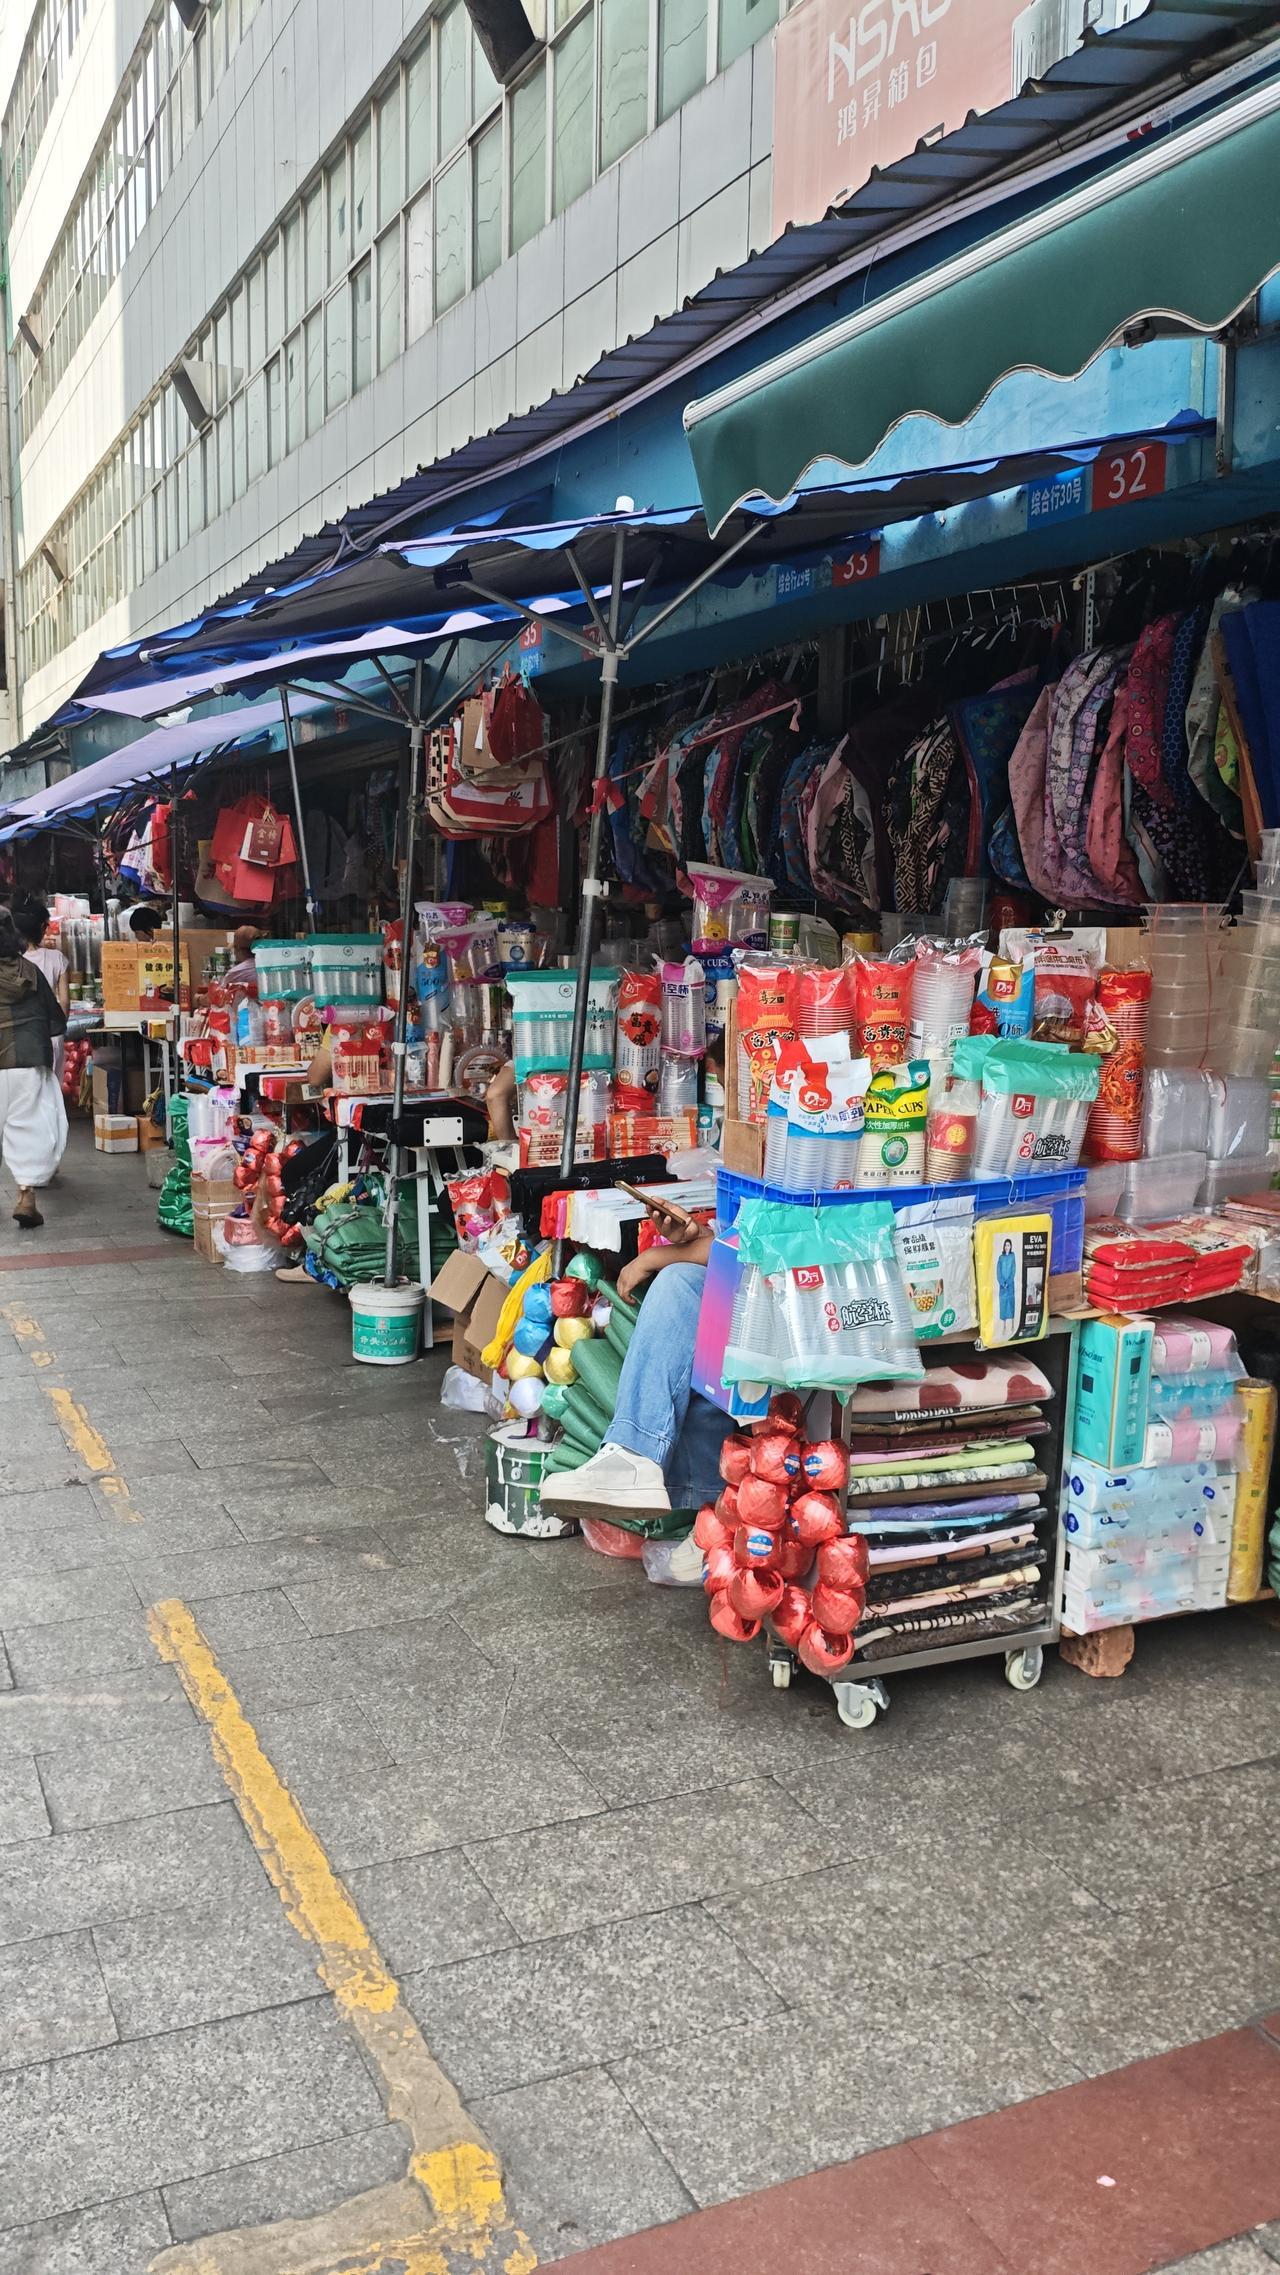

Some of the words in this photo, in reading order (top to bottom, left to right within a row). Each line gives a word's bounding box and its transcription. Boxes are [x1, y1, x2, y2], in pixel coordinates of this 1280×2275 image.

[837, 41, 937, 146] 鸿昇箱包
[1108, 451, 1147, 499] 32
[1030, 477, 1083, 516] 综合行30号
[706, 959, 729, 967] CUPS
[864, 1025, 906, 1041] 富贵碗
[898, 1101, 924, 1114] CUPS
[1034, 1137, 1071, 1157] 航空杯
[1029, 1235, 1043, 1243] EVA
[840, 1300, 891, 1326] 航空杯
